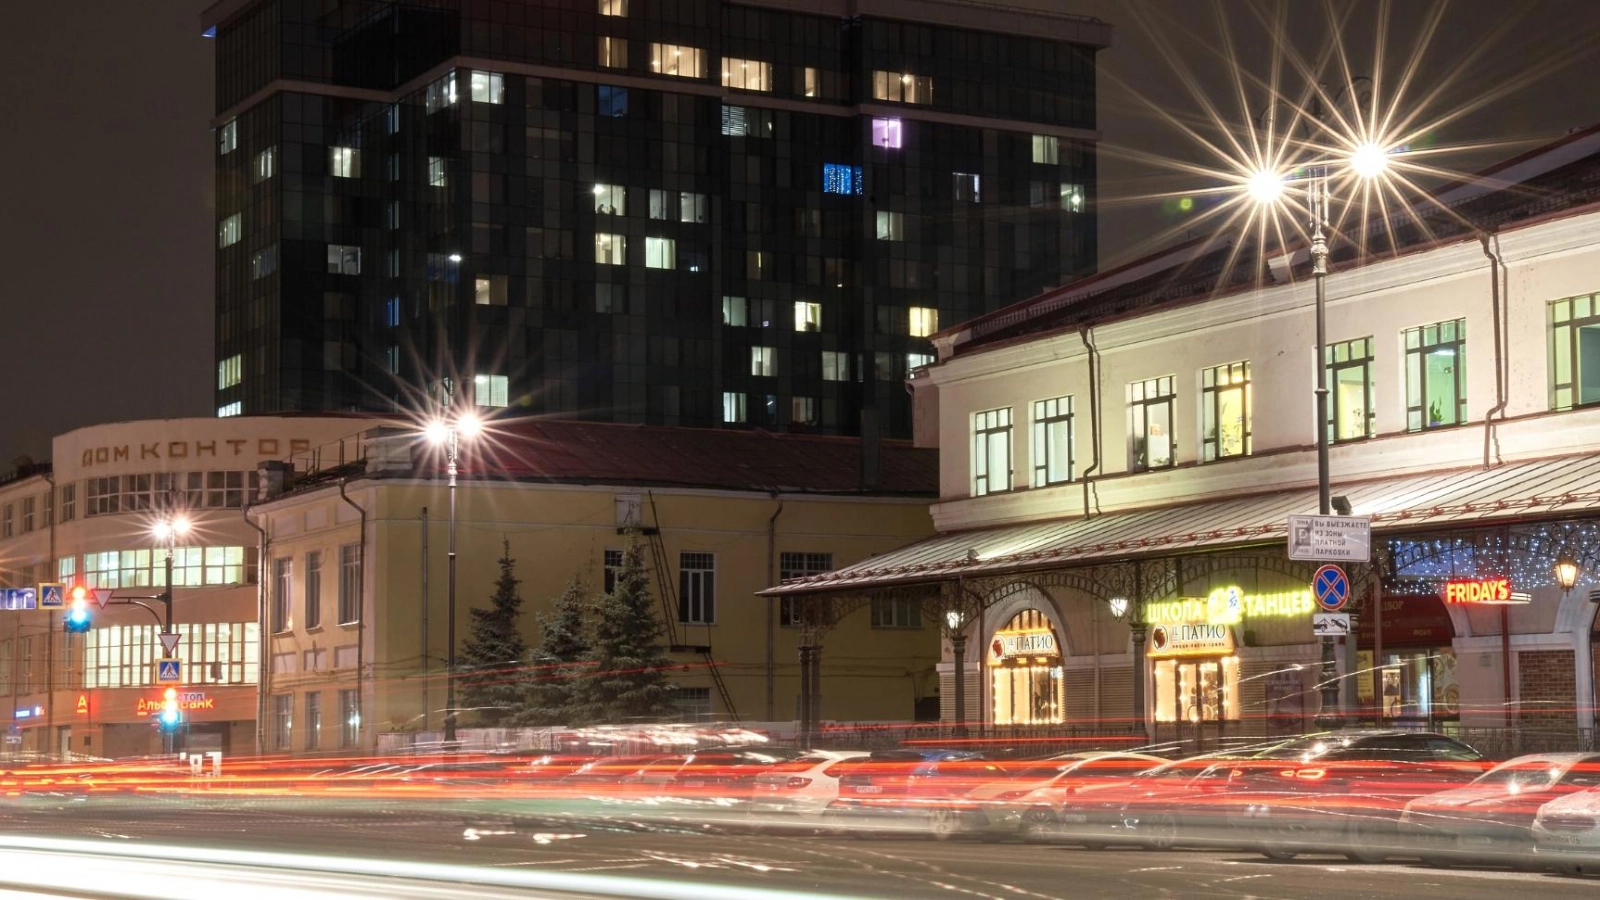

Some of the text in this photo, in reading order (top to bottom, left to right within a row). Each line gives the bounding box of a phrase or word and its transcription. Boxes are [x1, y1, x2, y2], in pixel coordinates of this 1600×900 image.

[82, 438, 311, 467] ДОМ КОНТОР
[1326, 520, 1367, 529] ВЫЕЗЖАЕТЕ
[1315, 548, 1351, 556] ПАРКОВКИ
[1446, 579, 1508, 603] FRIDAYS
[1147, 590, 1314, 624] ШКОЛА ТАНЦЕВ
[1181, 623, 1226, 641] ПАТИО
[1016, 634, 1053, 651] ПАТИО
